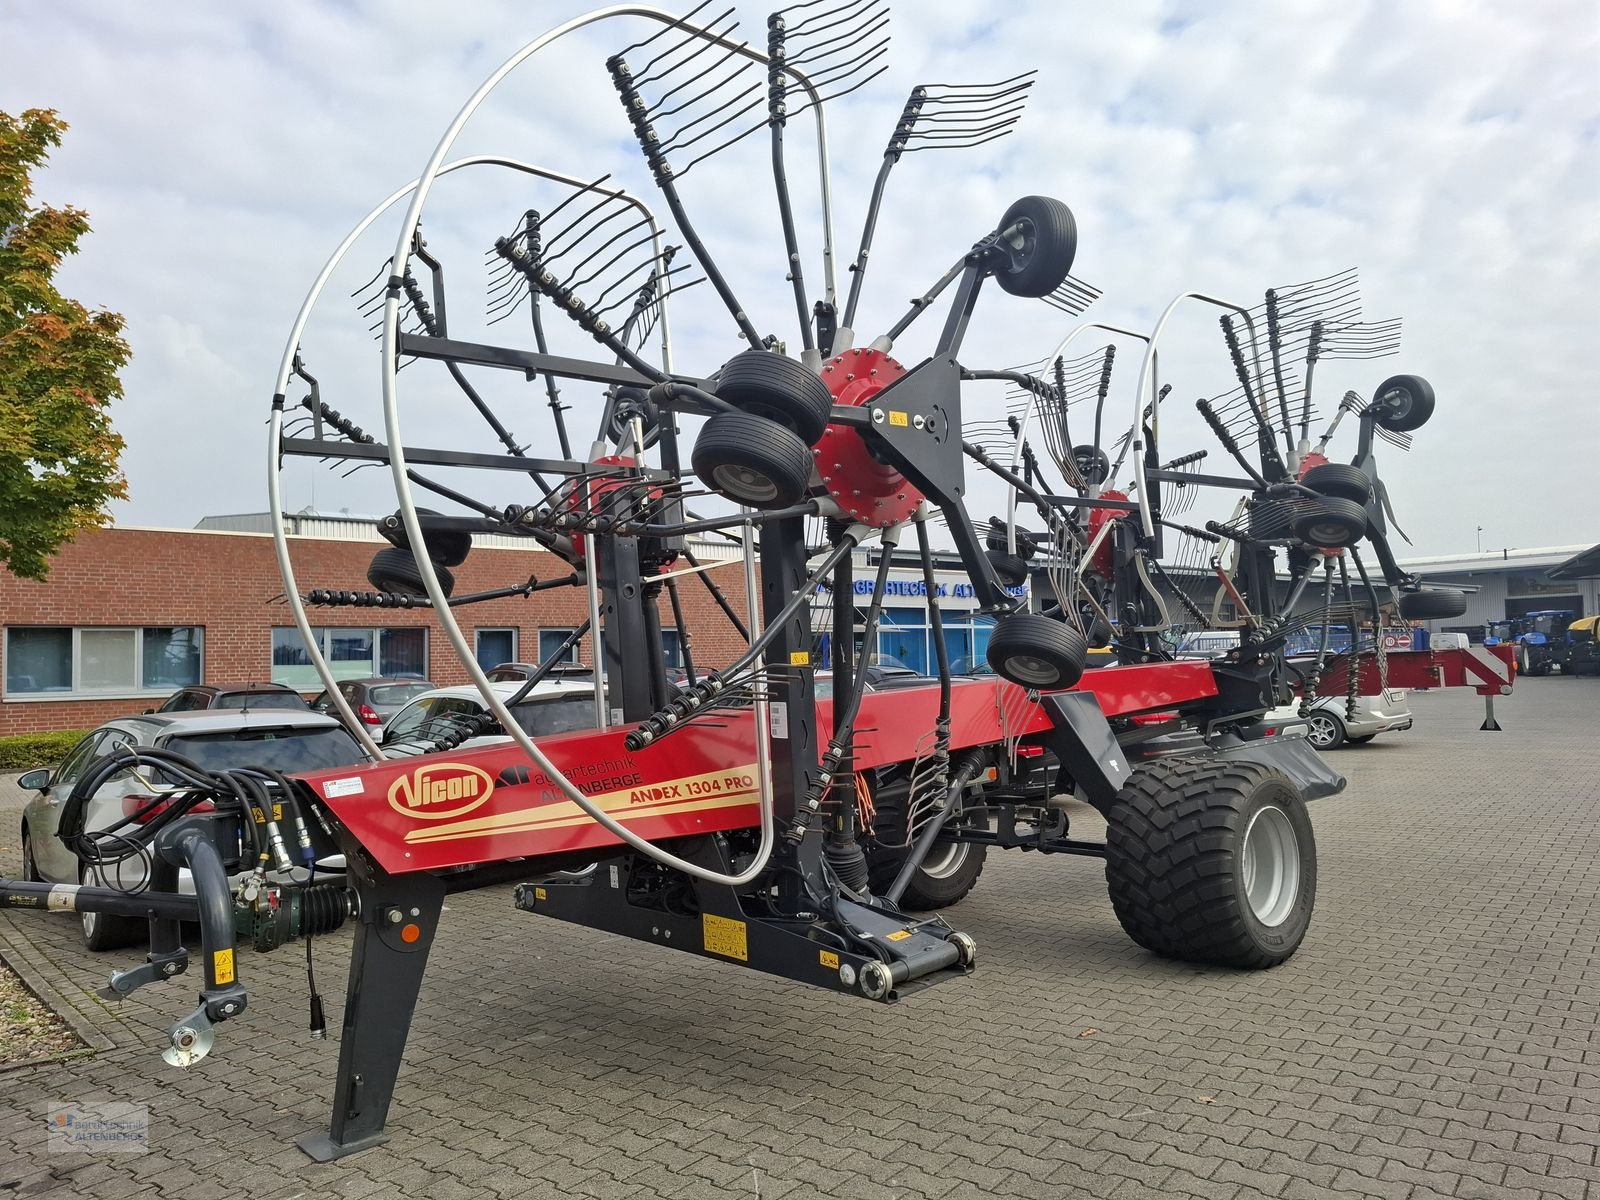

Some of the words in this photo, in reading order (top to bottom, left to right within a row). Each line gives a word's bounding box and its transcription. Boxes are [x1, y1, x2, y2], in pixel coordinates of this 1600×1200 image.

[534, 756, 637, 787] agartechnik
[397, 769, 480, 808] Vicon
[630, 785, 682, 804] ANDEX
[685, 779, 721, 796] 1304
[724, 775, 753, 790] PRO
